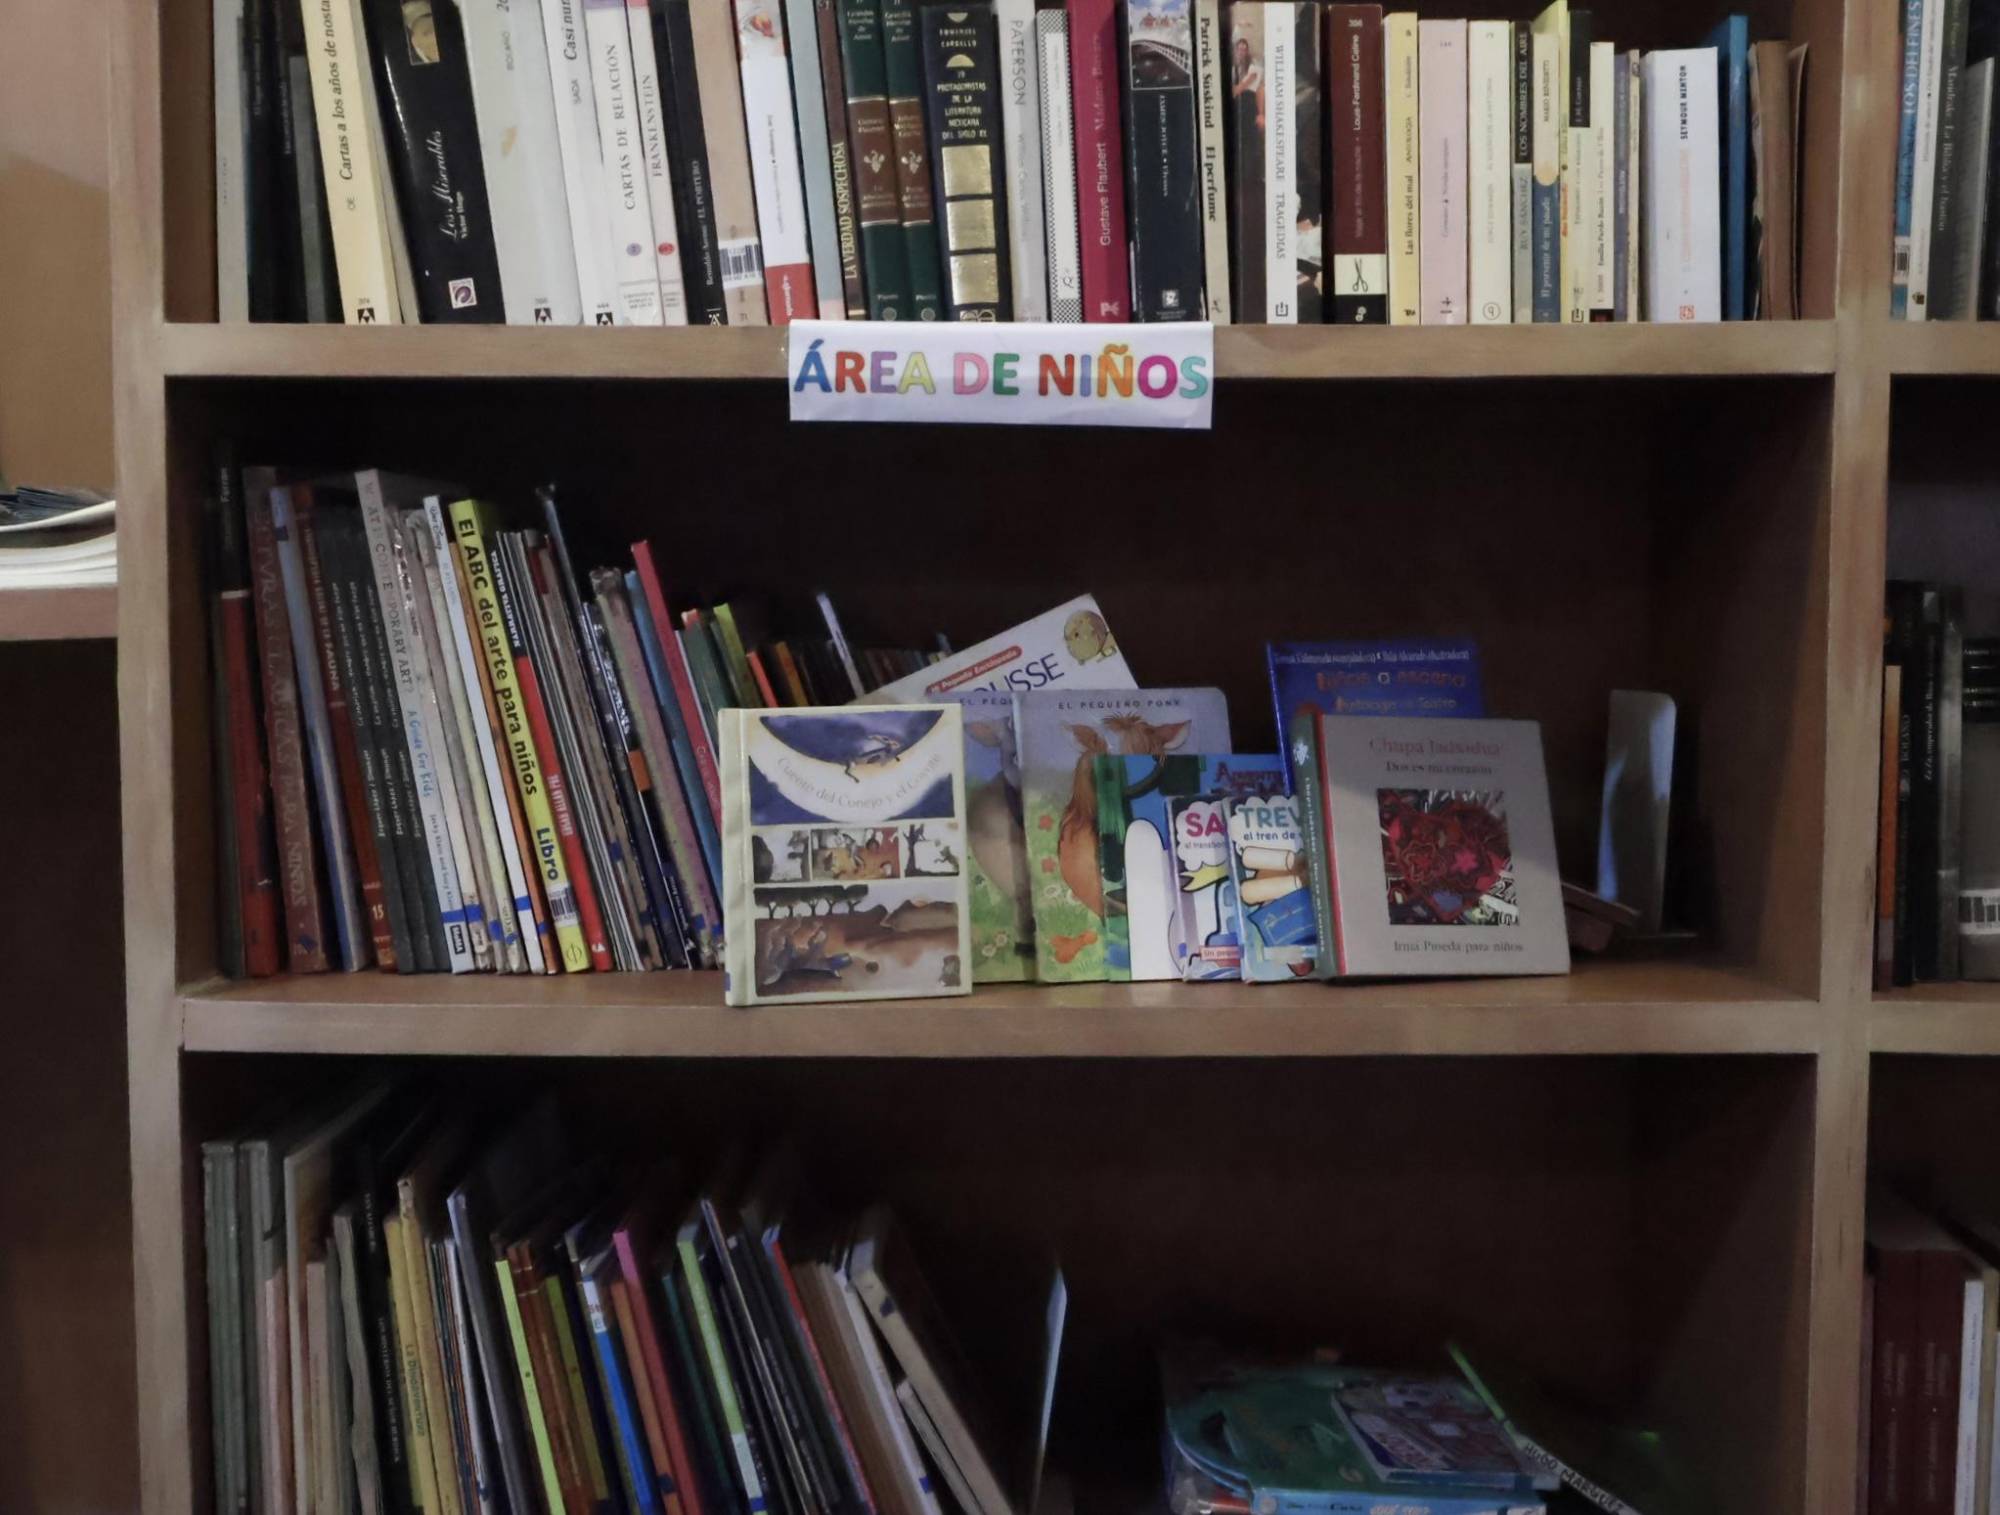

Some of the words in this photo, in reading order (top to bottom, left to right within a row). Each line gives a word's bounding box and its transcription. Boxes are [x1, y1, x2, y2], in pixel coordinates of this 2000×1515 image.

[328, 39, 338, 58] de
[563, 26, 578, 61] Casi
[1200, 17, 1213, 67] Patrick
[1520, 32, 1528, 56] AIRE
[329, 62, 343, 96] años
[1010, 20, 1026, 106] PATERSON
[1520, 60, 1528, 80] DEL
[332, 95, 346, 119] los
[964, 94, 972, 103] LA
[1202, 72, 1215, 129] Süskind
[1519, 82, 1528, 132] NOMBRES
[337, 123, 348, 131] a
[616, 128, 628, 147] DE
[1680, 101, 1688, 140] SEYMOUR
[339, 130, 353, 181] Cartas
[1204, 146, 1216, 160] El
[1520, 134, 1528, 156] LOS
[619, 154, 636, 210] CARTAS
[832, 142, 850, 215] SOSPECHOSA
[1096, 143, 1109, 193] Flaubert
[1406, 175, 1414, 192] mal
[1204, 160, 1218, 222] perfume
[1406, 194, 1414, 210] del
[840, 217, 856, 258] VERDAD
[1100, 197, 1111, 246] Gustave
[1275, 194, 1286, 260] TRAGEDIAS
[1404, 211, 1414, 238] flores
[1405, 240, 1414, 256] Las
[844, 260, 858, 280] LA
[794, 338, 938, 396] ÁREA
[953, 352, 1020, 396] DE
[1038, 344, 1209, 400] NIÑOS
[458, 518, 474, 538] El
[464, 544, 488, 590] ABC
[478, 598, 498, 629] del
[325, 643, 341, 692] FAUNA
[487, 635, 508, 681] arte
[496, 687, 522, 734] para
[1058, 702, 1074, 710] EL
[1080, 698, 1139, 709] PEQUEÑO
[513, 739, 537, 796] niños
[1243, 831, 1254, 841] el
[1256, 831, 1279, 841] tren
[1282, 830, 1296, 841] de
[536, 827, 559, 881] Libro
[372, 904, 384, 920] 15
[1393, 940, 1420, 953] Irma
[1424, 940, 1461, 952] Pineda
[1464, 943, 1489, 954] para
[1492, 941, 1523, 953] niños
